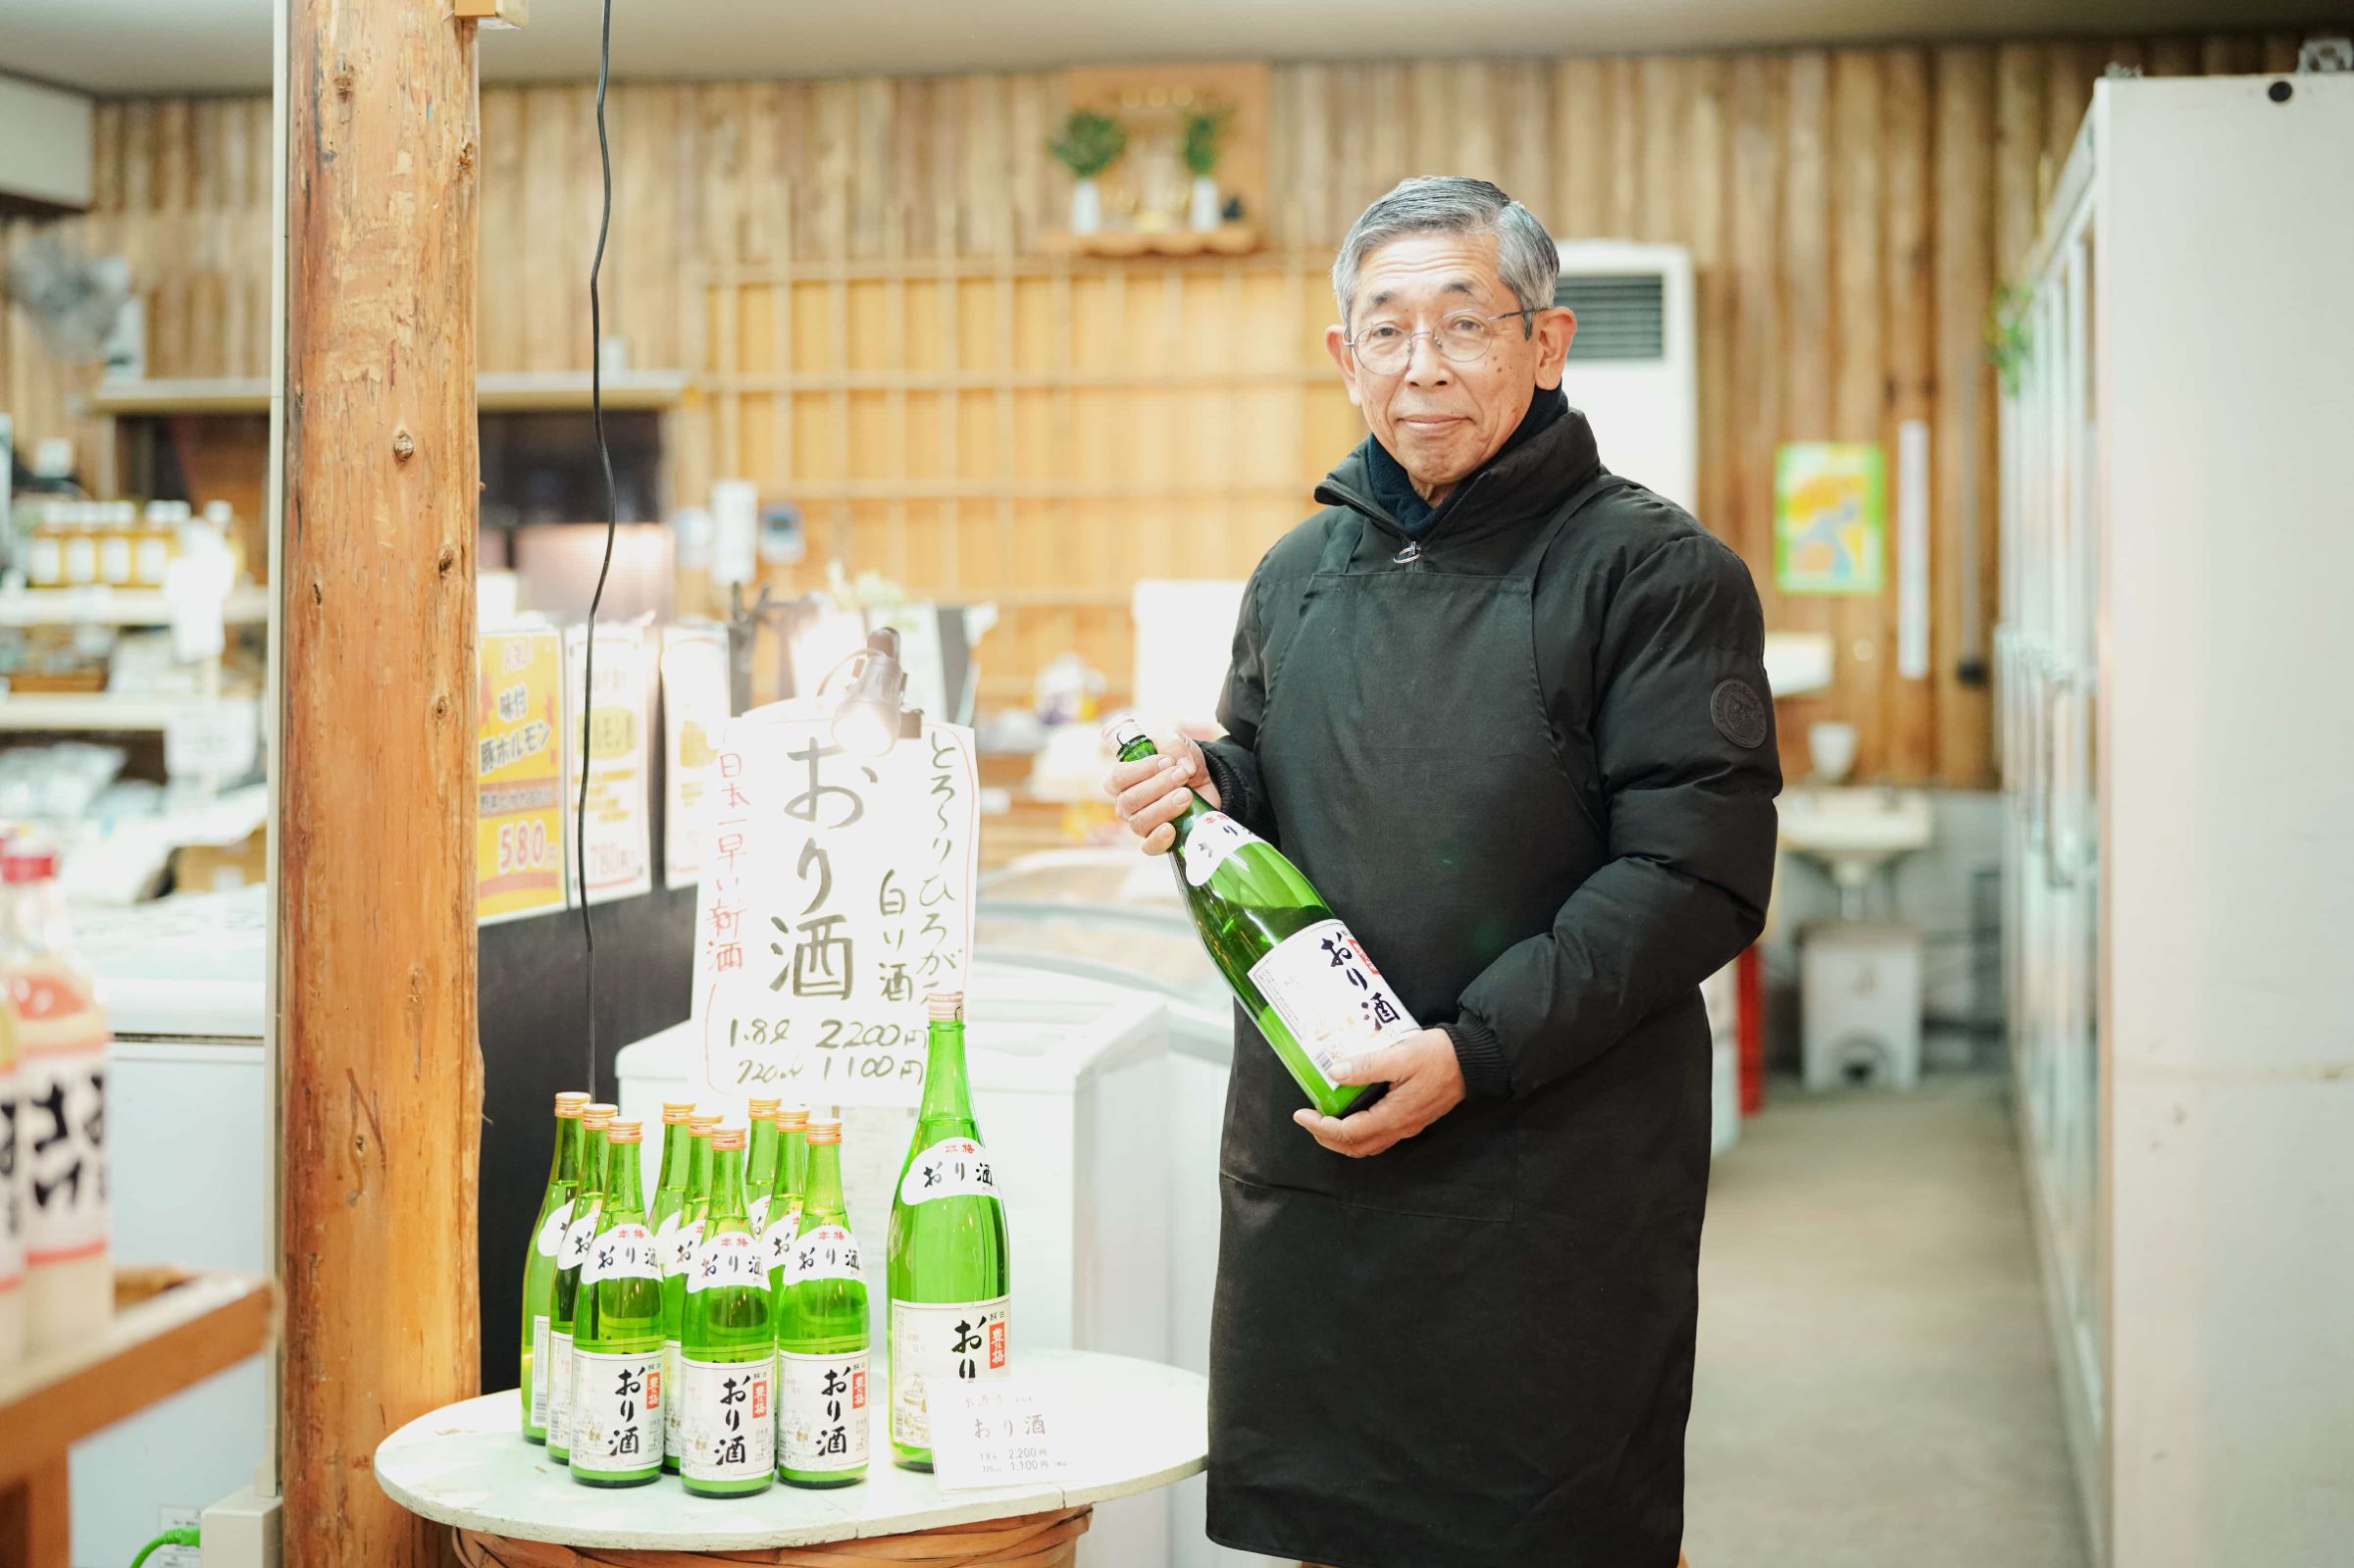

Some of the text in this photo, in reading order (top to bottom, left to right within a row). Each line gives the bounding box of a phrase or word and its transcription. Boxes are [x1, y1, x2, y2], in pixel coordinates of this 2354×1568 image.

[706, 752, 752, 973] 日本一早い新酒
[769, 736, 880, 1001] おり酒
[1320, 932, 1402, 1032] おり酒
[815, 1019, 928, 1050] 2200円
[823, 1055, 925, 1086] 1100円
[923, 1161, 993, 1189] おり酒
[607, 1366, 646, 1456] おり酒
[713, 1375, 751, 1466] おり酒
[815, 1366, 851, 1456] おり酒
[974, 1413, 1046, 1439] おり酒
